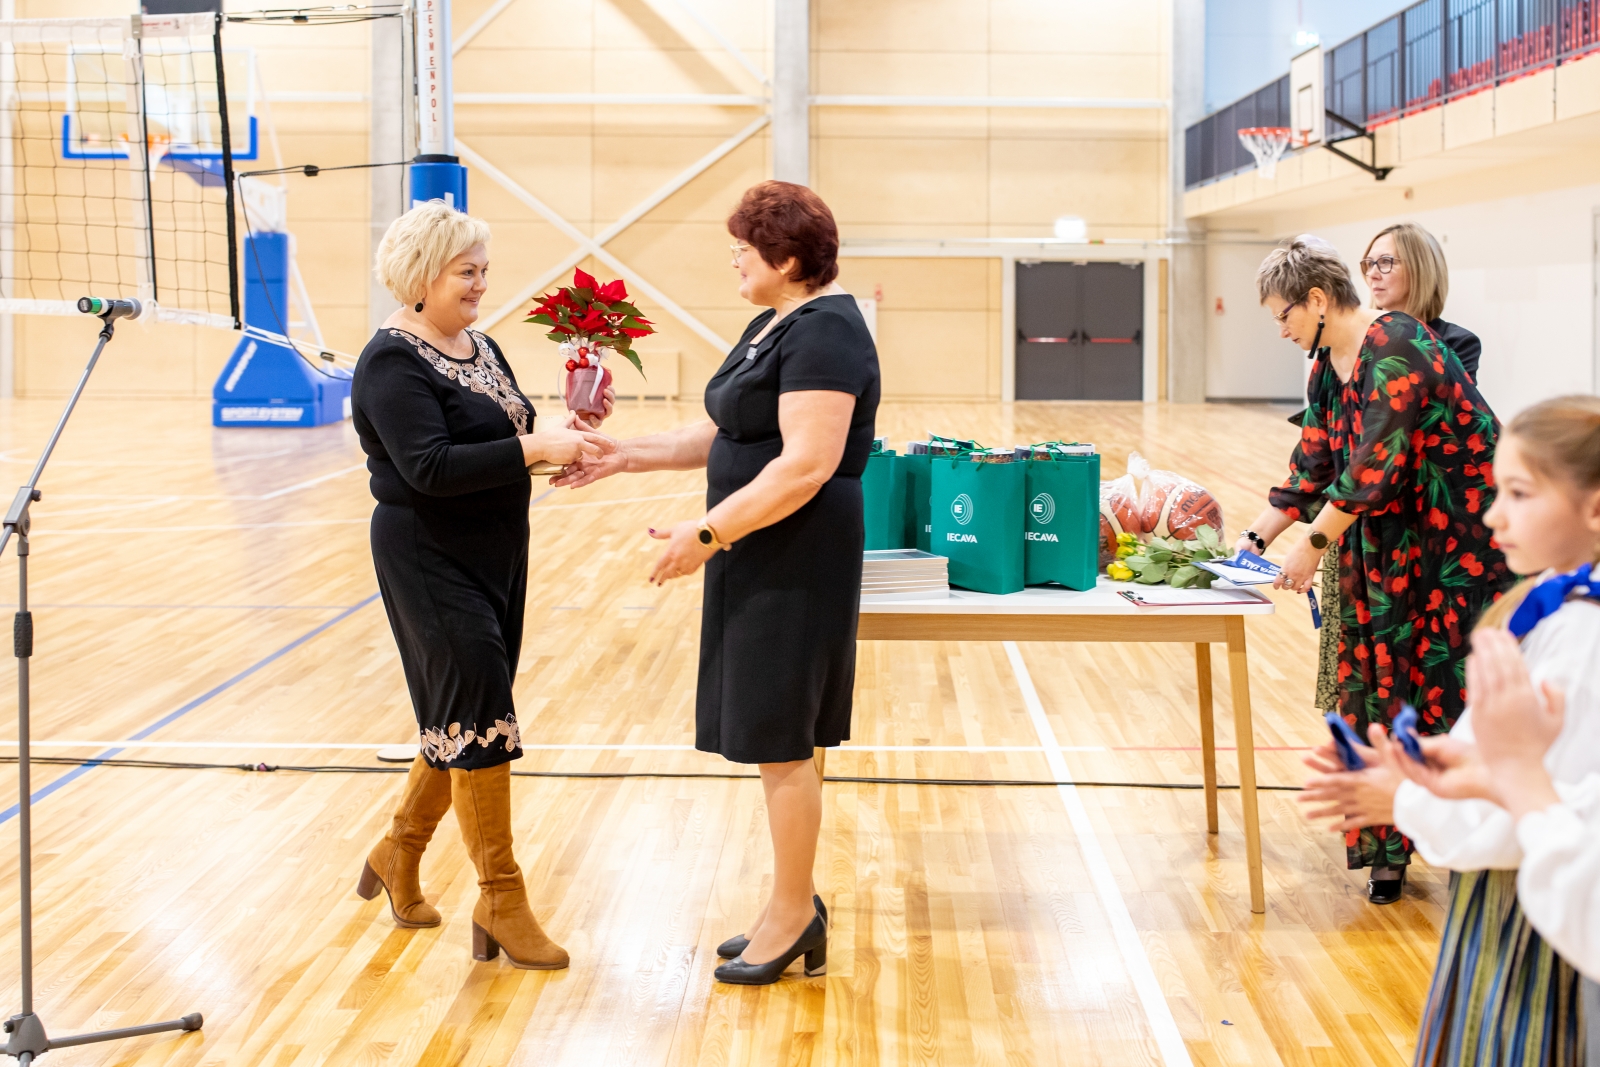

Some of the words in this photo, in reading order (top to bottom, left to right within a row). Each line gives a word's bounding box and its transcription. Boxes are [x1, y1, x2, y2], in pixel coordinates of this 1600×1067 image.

[427, 0, 437, 122] PESMENPOL
[954, 504, 963, 513] IE
[1033, 503, 1043, 513] IE
[947, 533, 978, 543] IECAVA
[1025, 532, 1059, 542] IECAVA
